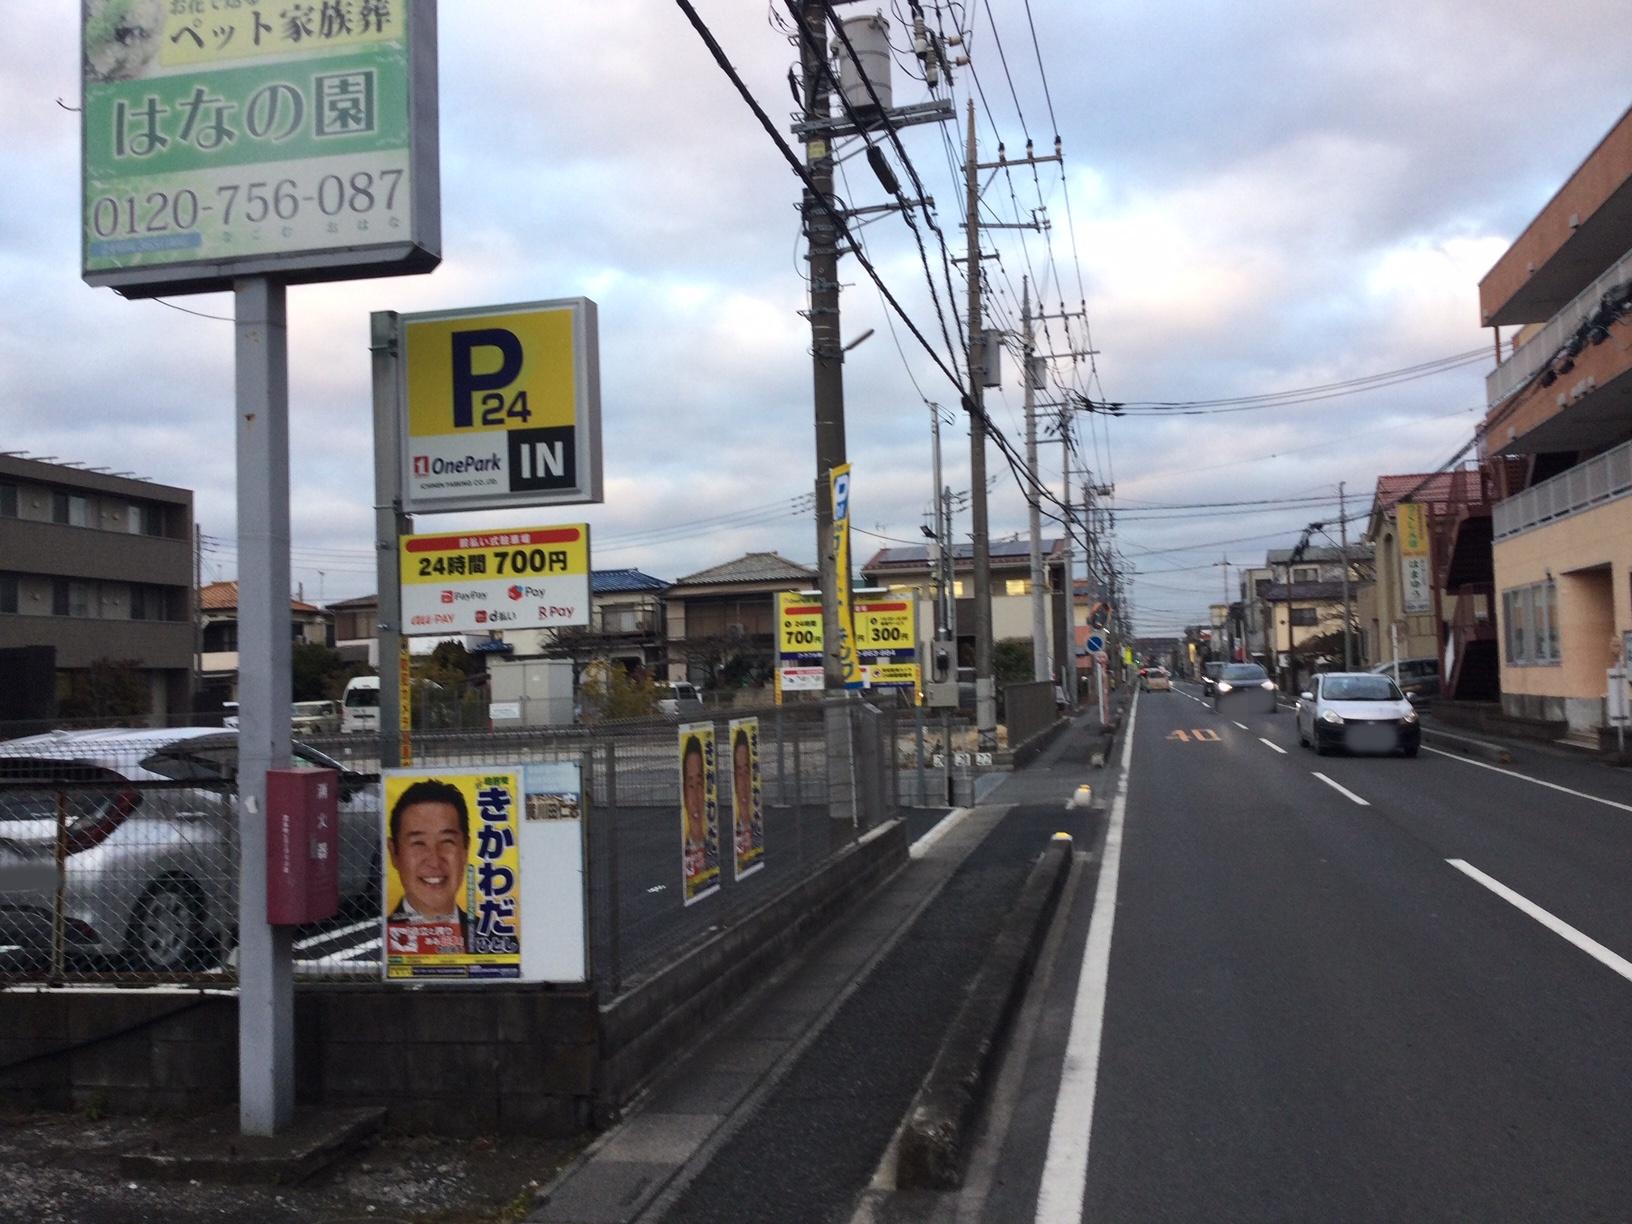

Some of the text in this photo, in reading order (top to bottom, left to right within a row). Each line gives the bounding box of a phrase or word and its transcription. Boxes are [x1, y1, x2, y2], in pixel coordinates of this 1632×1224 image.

[171, 0, 391, 49] ペット家族葬
[116, 71, 375, 157] はなの園
[94, 170, 404, 237] 0120-756-087
[452, 328, 523, 428] P
[482, 391, 531, 426] 24
[432, 452, 502, 475] OnePark
[520, 441, 565, 479] IN
[419, 549, 568, 576] 24時間 700円
[454, 590, 488, 601] PayPay
[525, 586, 546, 599] Pay
[550, 606, 575, 618] Pay
[786, 630, 822, 644] 700円
[872, 627, 910, 642] 300円
[1166, 729, 1222, 742] 40
[477, 787, 515, 936] きかわだ
